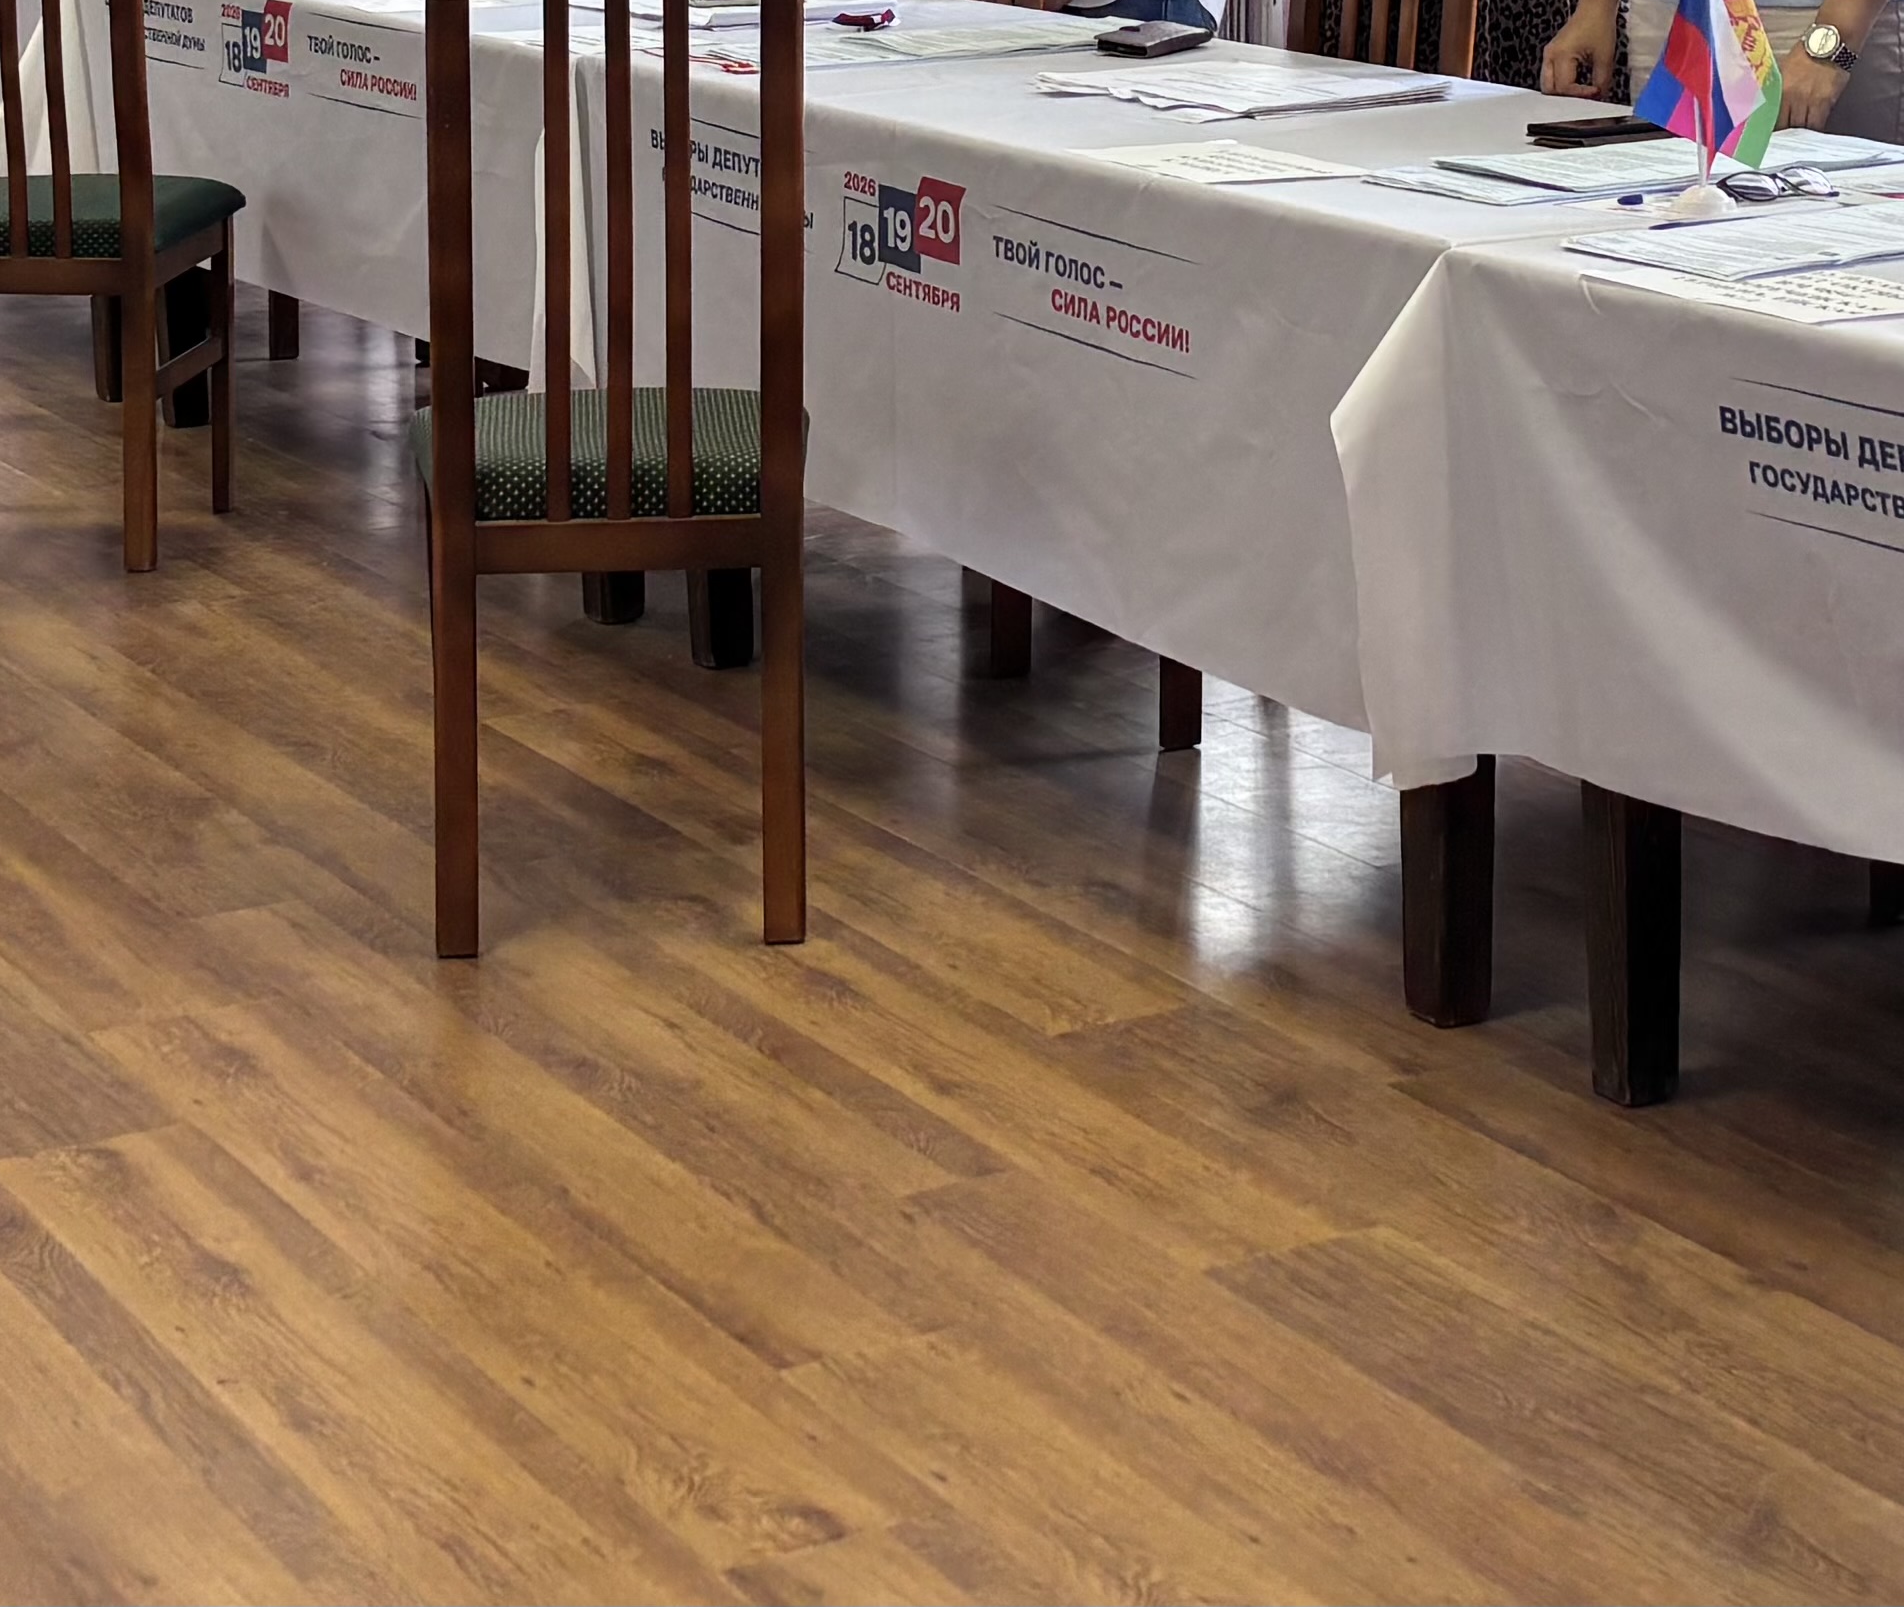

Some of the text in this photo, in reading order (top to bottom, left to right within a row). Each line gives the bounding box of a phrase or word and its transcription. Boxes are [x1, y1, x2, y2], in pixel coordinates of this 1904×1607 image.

[225, 14, 286, 73] 18 19 20
[307, 35, 335, 56] ТВОЙ
[336, 42, 372, 64] ГОЛОС
[246, 74, 289, 98] СЕНТЯБРЯ
[340, 69, 417, 101] СИЛА РОССИИ!
[712, 146, 760, 177] ДЕПУТ
[844, 171, 876, 196] 2026
[848, 195, 955, 266] 18 19 20
[993, 235, 1040, 271] ТВОЙ
[1045, 251, 1105, 289] ГОЛОС
[886, 271, 960, 313] СЕНТЯБРЯ
[1051, 288, 1190, 354] СИЛА РОССИИ!
[1719, 405, 1850, 460] ВЫБОРЫ
